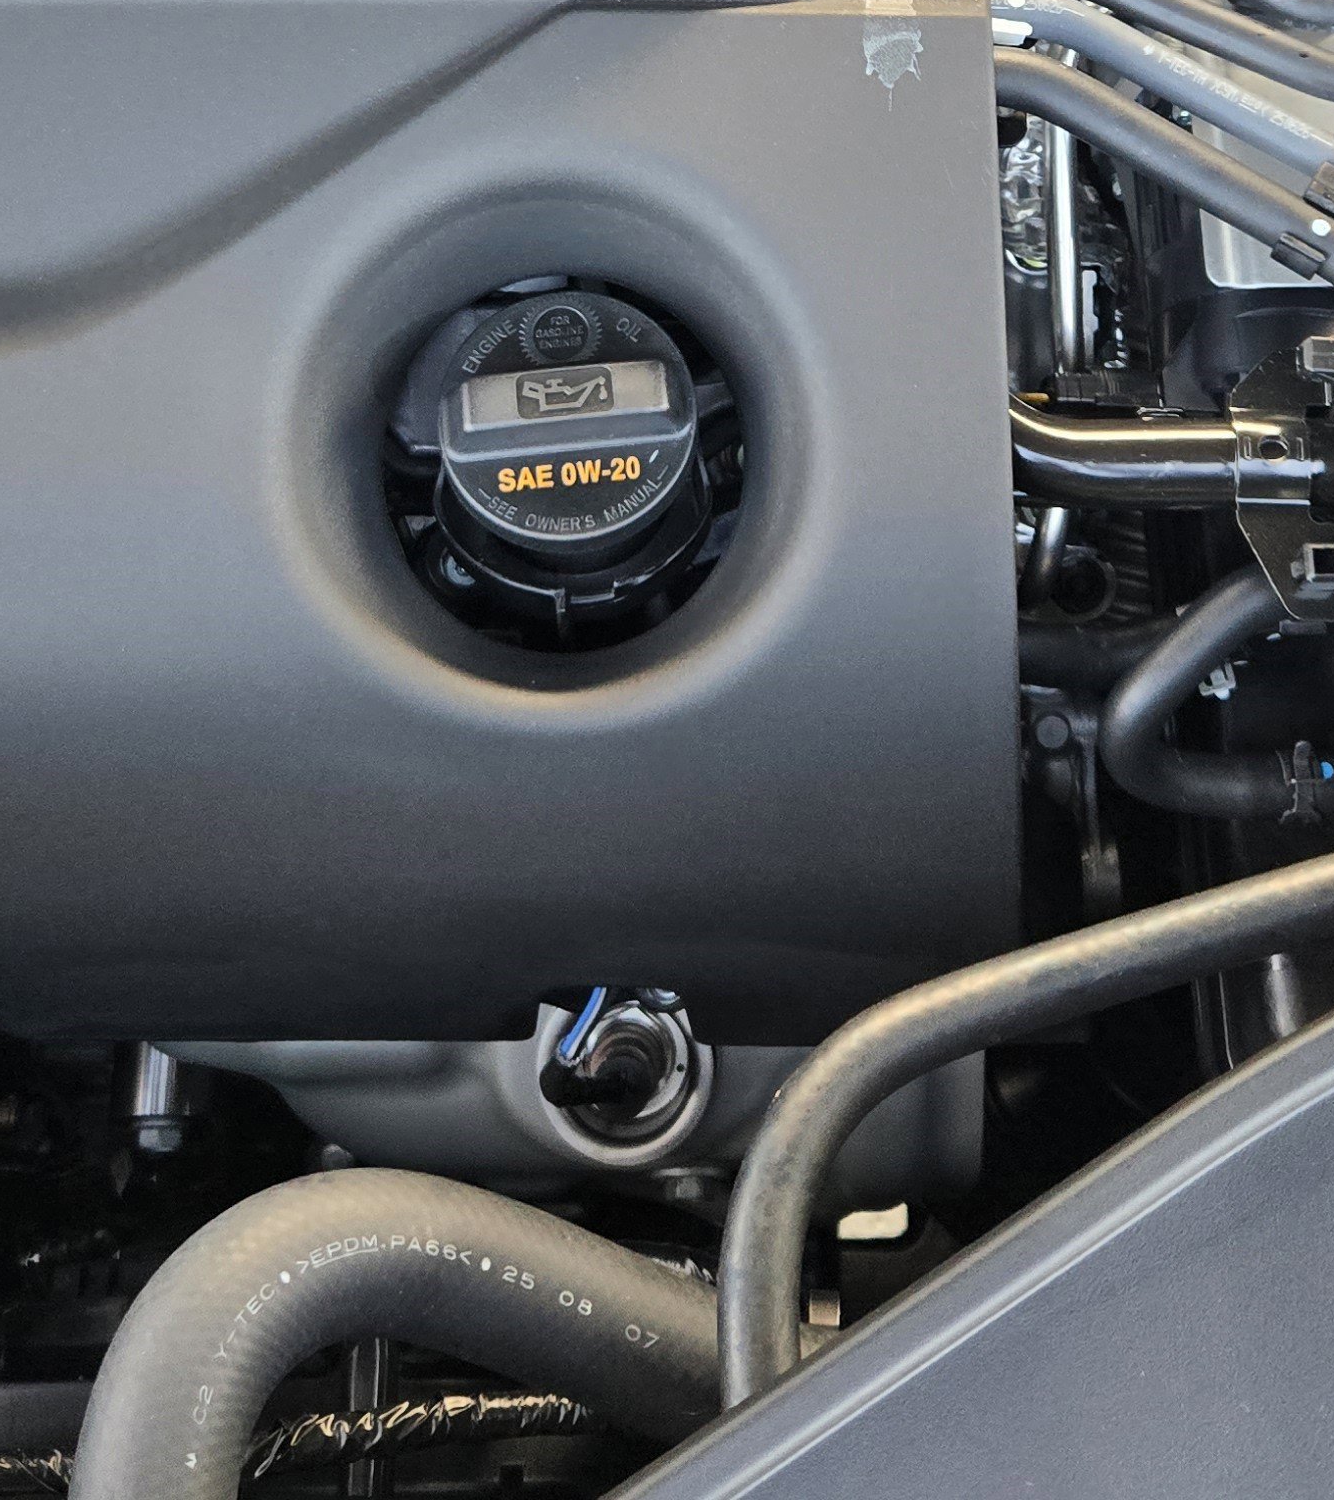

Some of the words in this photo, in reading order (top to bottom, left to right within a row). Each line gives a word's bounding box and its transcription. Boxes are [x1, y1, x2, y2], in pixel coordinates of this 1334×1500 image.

[535, 324, 585, 340] GASOLINE
[550, 315, 571, 326] FOR
[461, 319, 517, 375] ENGINE
[616, 316, 643, 343] OIL
[497, 465, 555, 493] SAE
[560, 455, 642, 487] 0W-20
[525, 513, 596, 532] OWNER'S
[605, 477, 663, 523] MANUAL
[502, 1265, 536, 1291] 25
[559, 1291, 593, 1316] 08
[624, 1323, 661, 1349] 07
